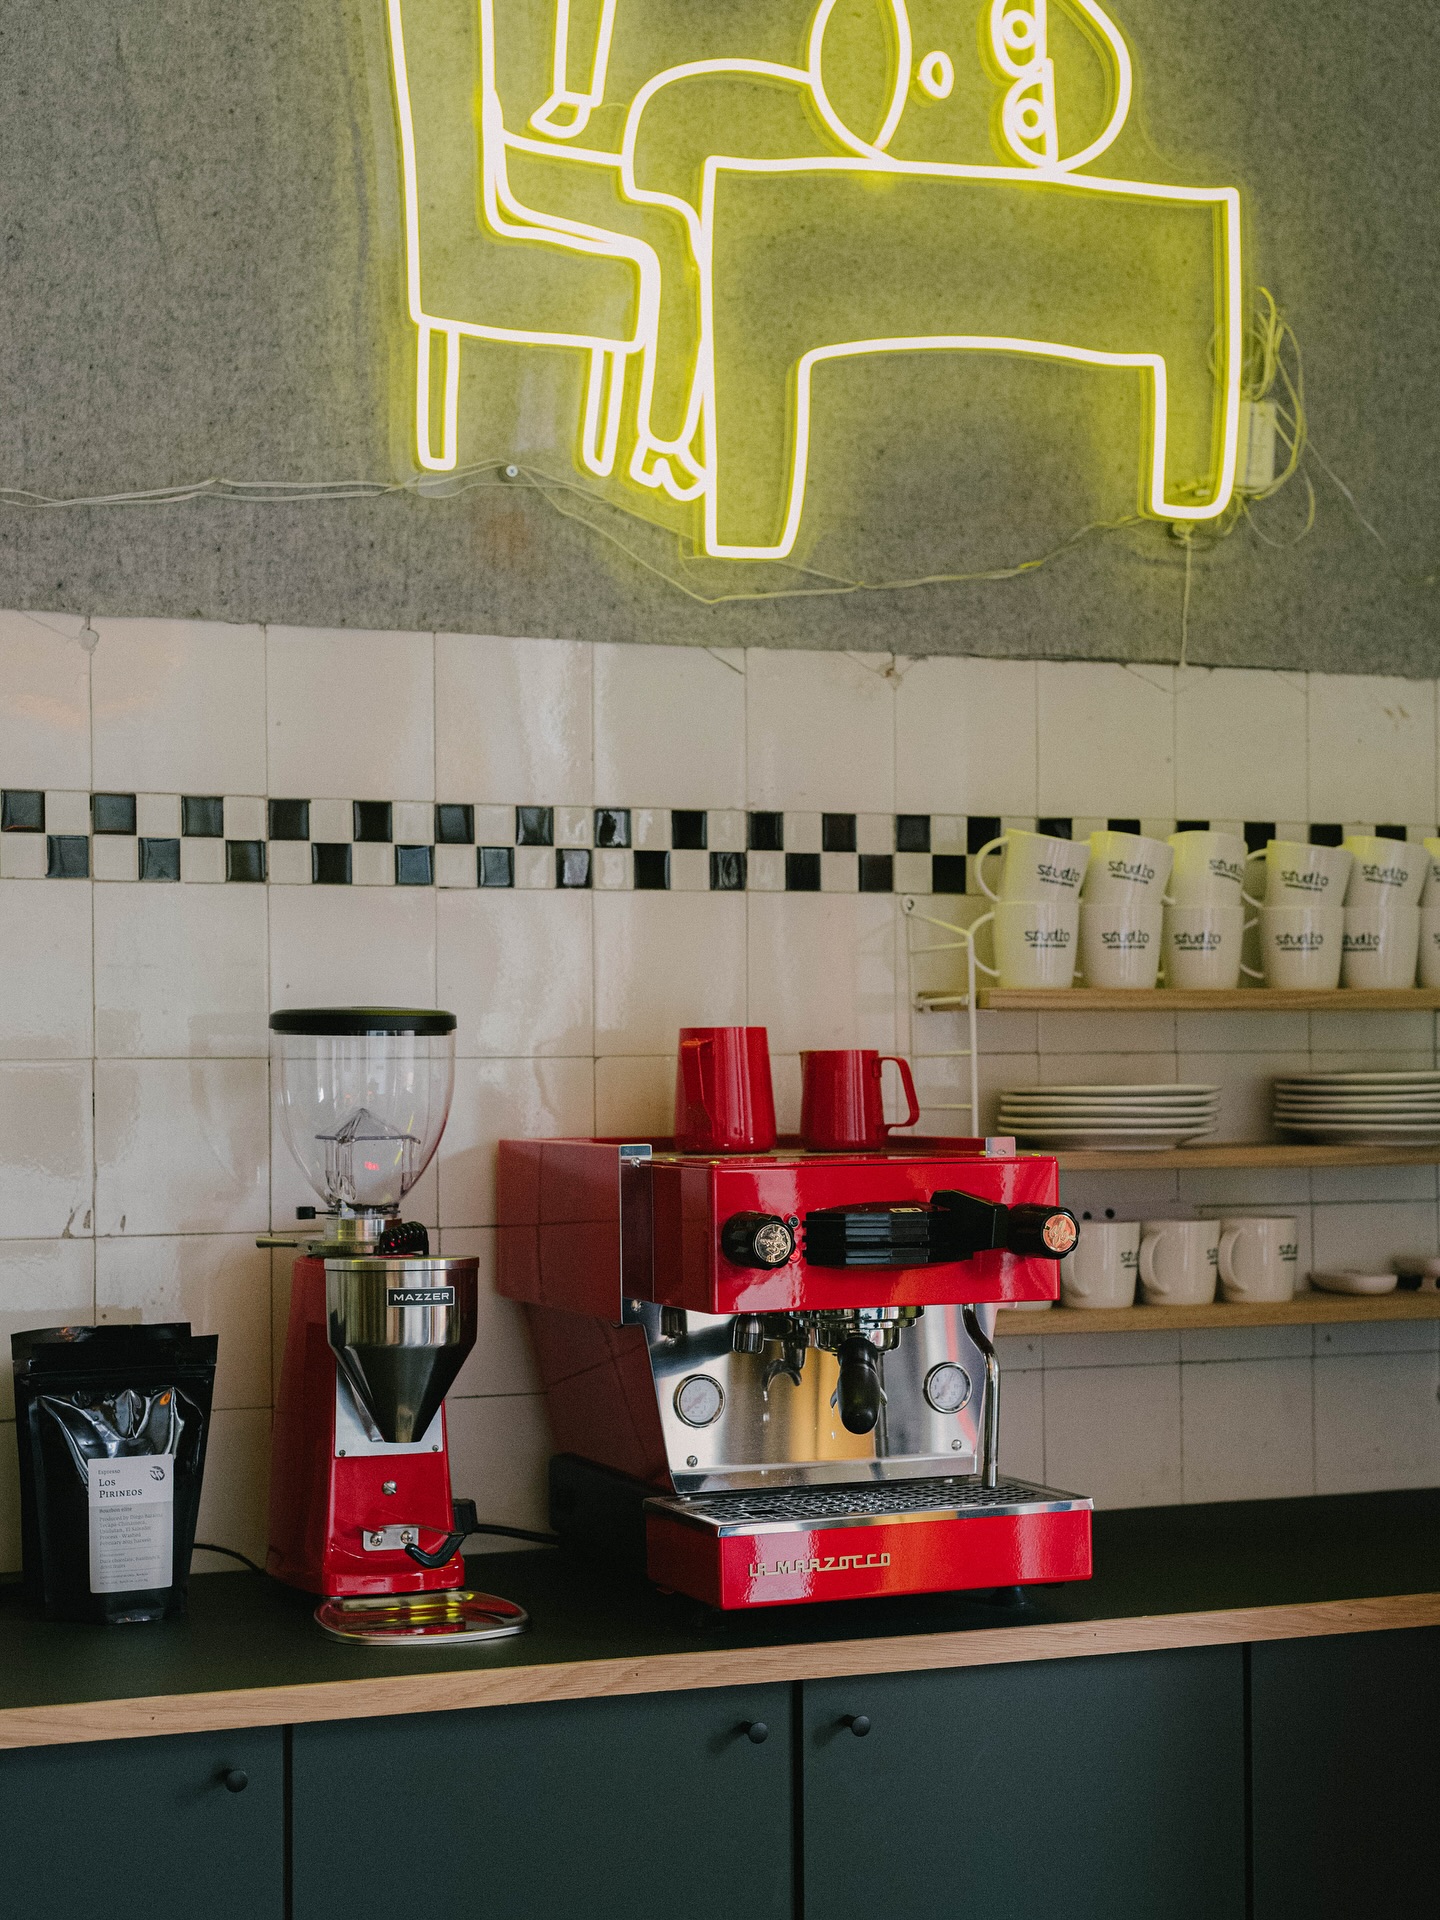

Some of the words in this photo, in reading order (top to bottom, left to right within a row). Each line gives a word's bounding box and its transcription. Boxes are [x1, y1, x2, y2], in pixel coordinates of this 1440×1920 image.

[1037, 864, 1081, 883] studio
[1108, 860, 1155, 880] studio
[1363, 864, 1408, 882] studio
[1281, 870, 1329, 887] studio
[1024, 929, 1070, 942] studio
[1101, 929, 1150, 944] studio
[1173, 931, 1221, 945] studio
[1276, 931, 1324, 946] studio
[393, 1292, 450, 1302] MAZZER
[748, 1562, 767, 1577] LA
[777, 1552, 891, 1576] MARZOCCO
